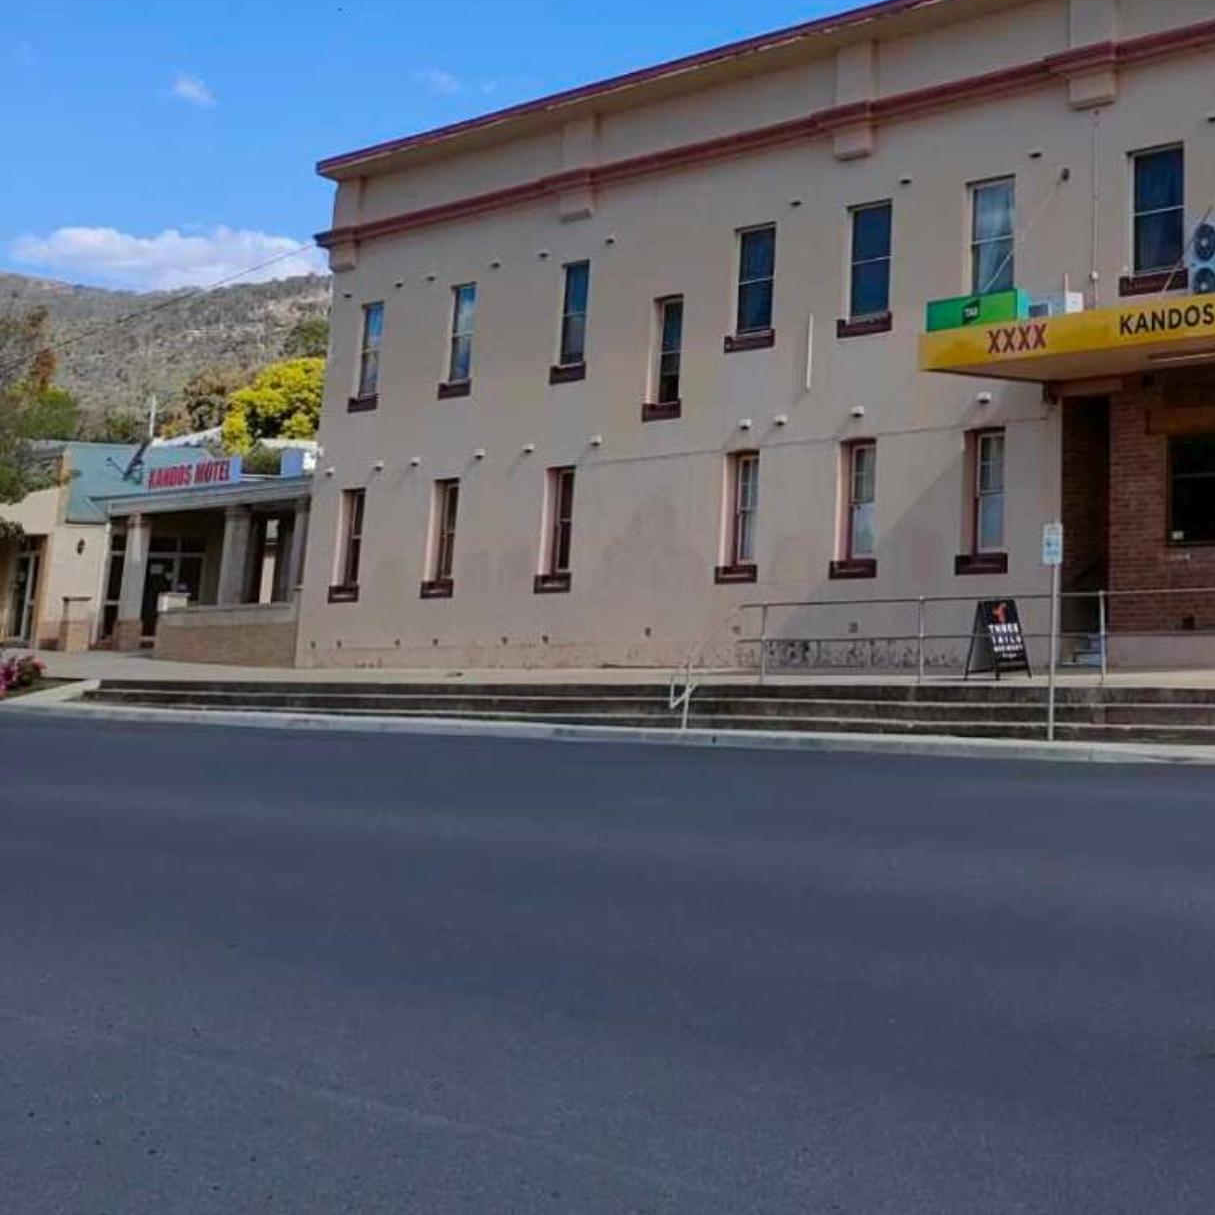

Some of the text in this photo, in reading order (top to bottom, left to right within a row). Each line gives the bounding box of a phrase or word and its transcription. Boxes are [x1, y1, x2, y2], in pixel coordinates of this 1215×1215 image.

[1119, 303, 1215, 336] KANDOS
[988, 323, 1047, 354] XXXX
[148, 465, 191, 489] KANDOS
